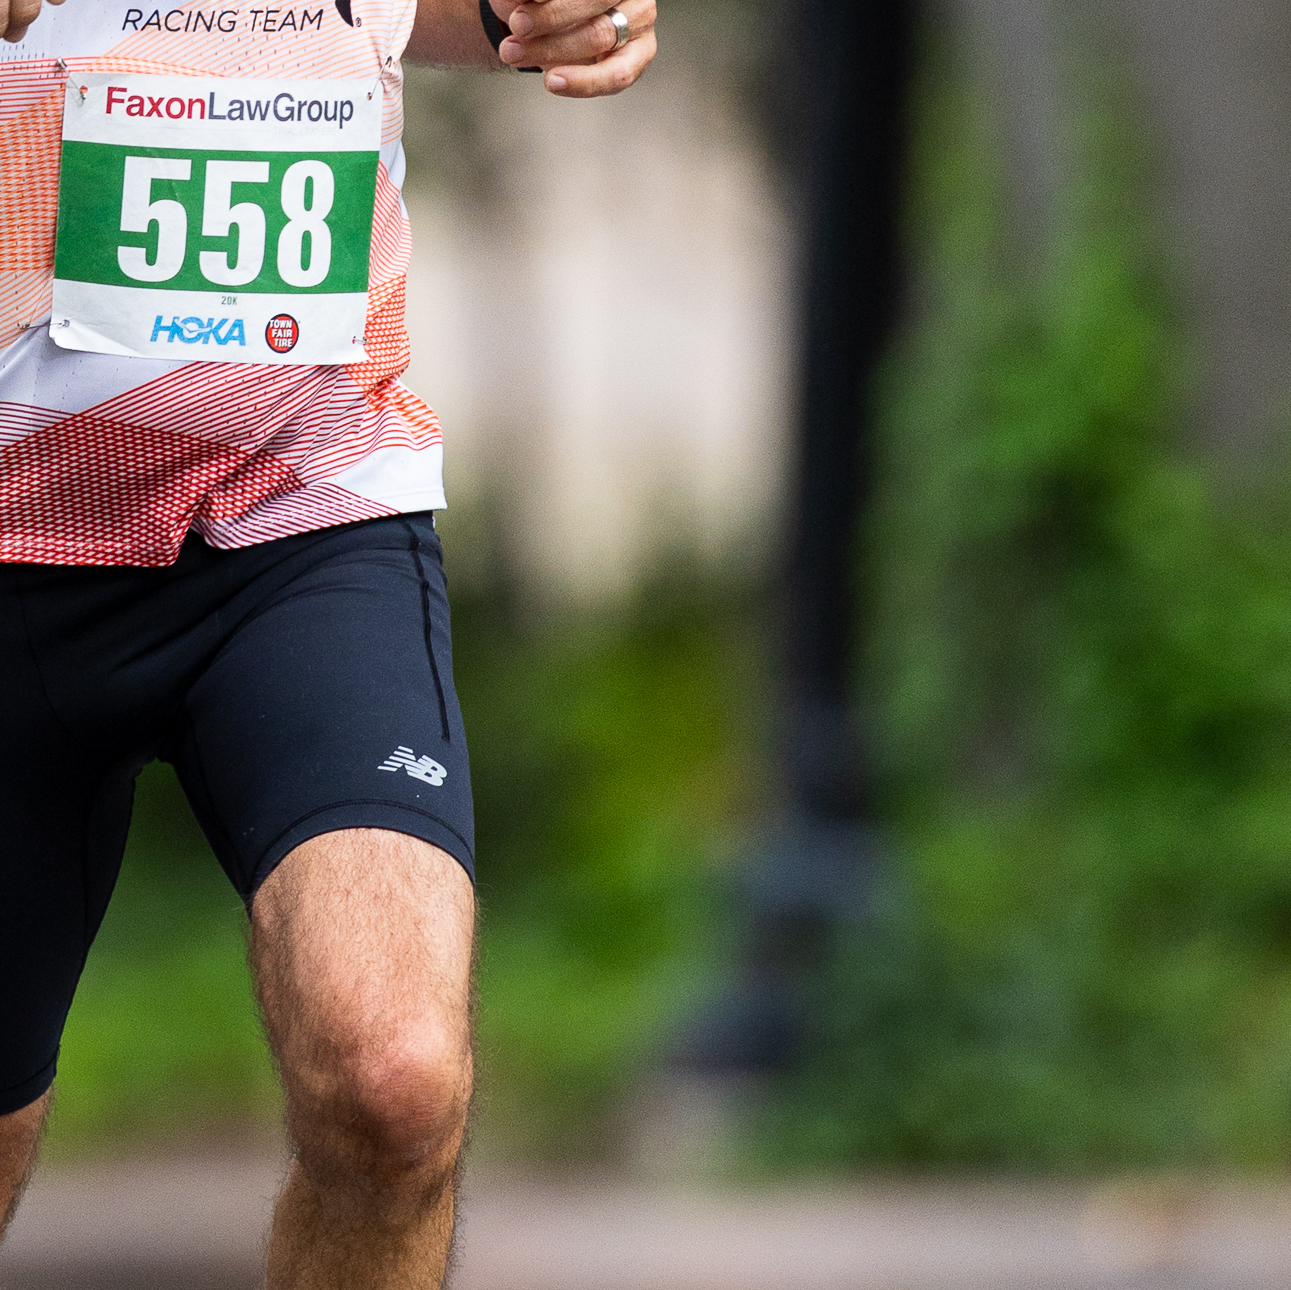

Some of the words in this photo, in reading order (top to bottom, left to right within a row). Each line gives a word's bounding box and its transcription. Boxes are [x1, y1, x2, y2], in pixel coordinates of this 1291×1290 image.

[122, 8, 238, 33] RACING
[249, 8, 324, 32] TEAM
[105, 86, 355, 129] FaxonLawGroup
[117, 155, 335, 289] 558
[221, 296, 238, 306] 20K
[149, 315, 247, 347] HOKA
[270, 319, 293, 329] TOWN
[272, 329, 293, 339] FAIR
[274, 339, 293, 347] TIRE
